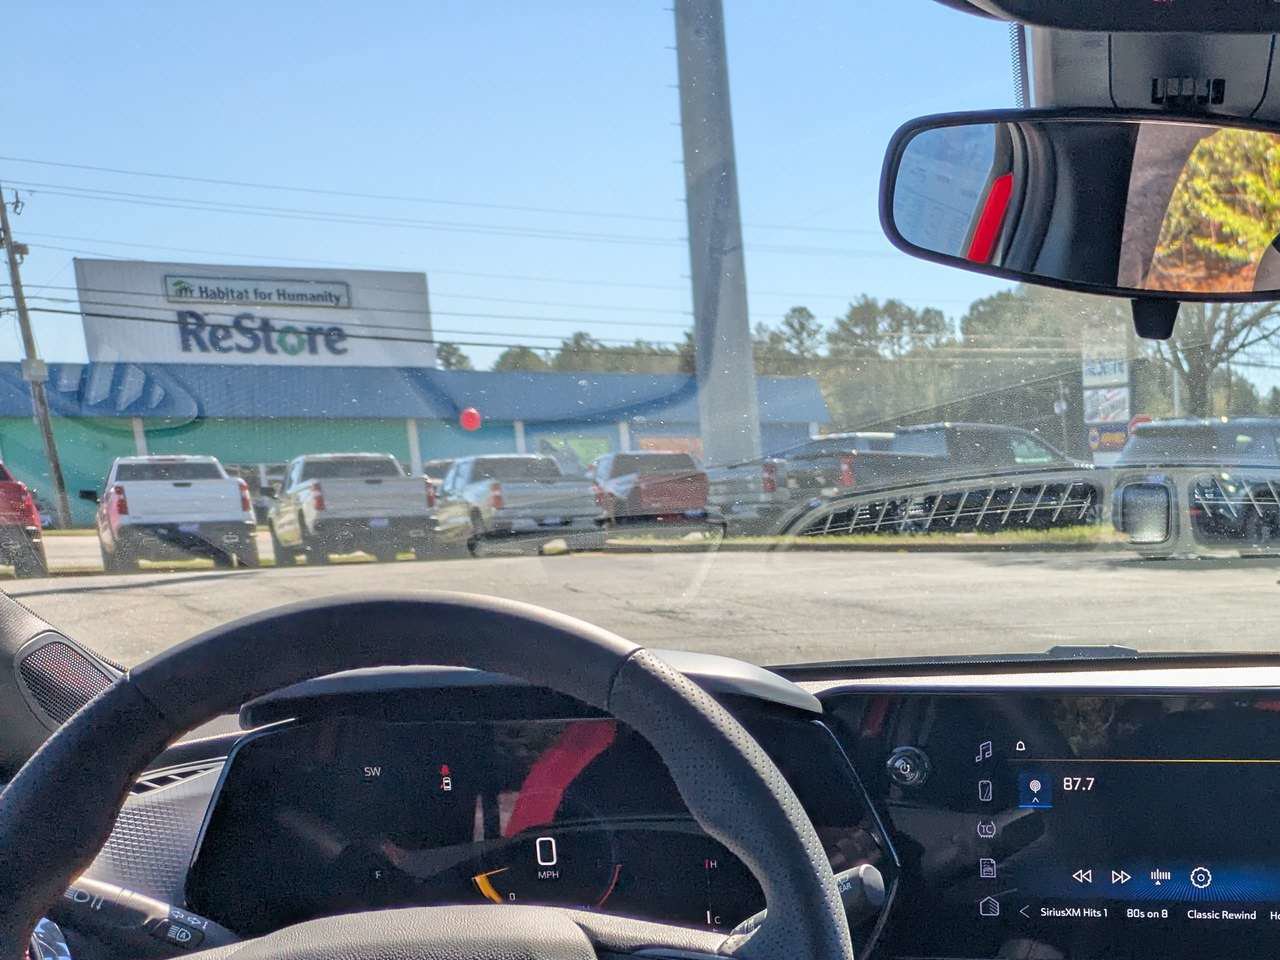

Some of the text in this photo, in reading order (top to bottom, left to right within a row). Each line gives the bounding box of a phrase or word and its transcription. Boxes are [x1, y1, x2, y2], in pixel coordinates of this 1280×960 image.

[199, 286, 342, 305] Habitat for Humanity
[176, 310, 348, 356] ReStore
[364, 766, 381, 777] SW
[1063, 777, 1095, 791] 87.7
[536, 837, 557, 866] 0
[710, 860, 717, 869] H
[538, 871, 559, 880] MPH
[509, 892, 516, 902] 0
[1040, 907, 1081, 917] SiriusXM
[1083, 908, 1102, 917] Hits
[1126, 908, 1168, 918] 80s on 8
[1187, 909, 1257, 920] Classic Rewind
